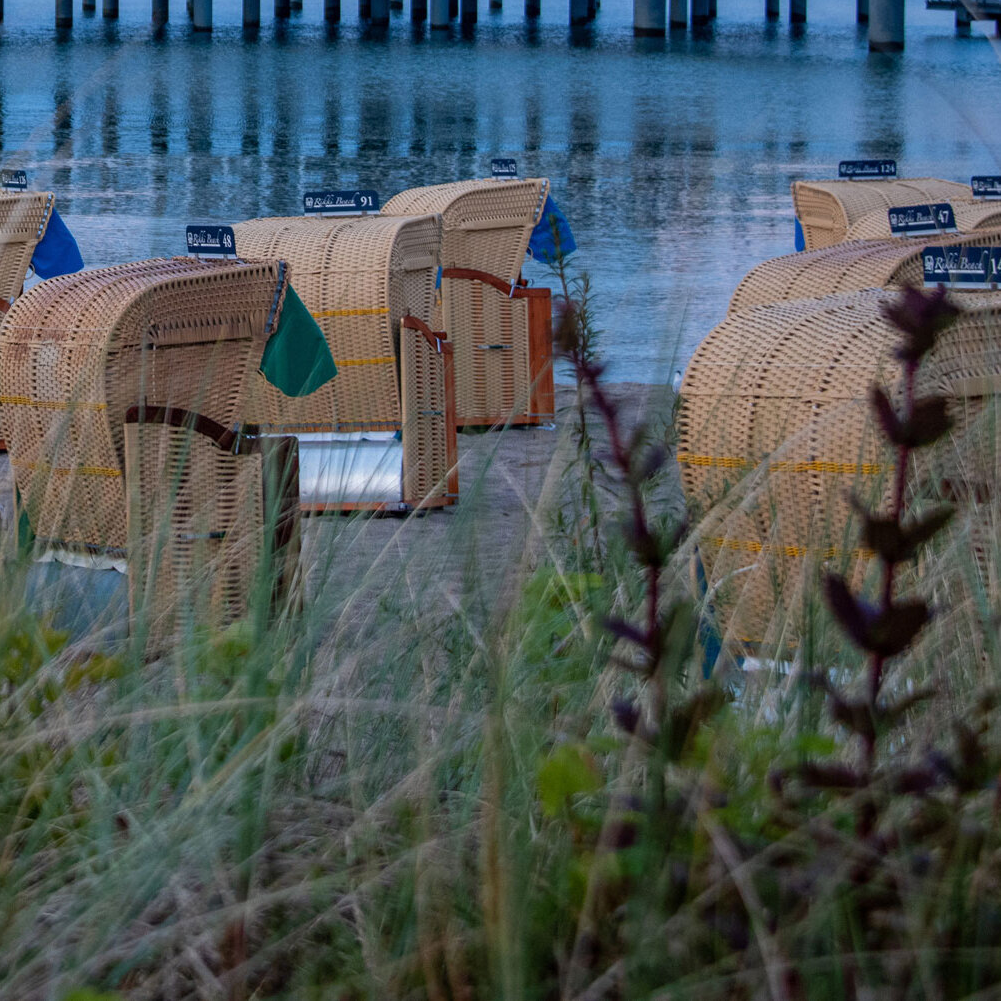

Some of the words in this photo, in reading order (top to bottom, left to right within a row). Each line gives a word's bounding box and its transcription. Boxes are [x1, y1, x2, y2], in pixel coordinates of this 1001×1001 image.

[360, 196, 373, 207] 91
[938, 210, 949, 224] 47
[222, 233, 232, 248] 48
[934, 252, 958, 272] Rikki
[960, 250, 989, 270] Beach
[990, 258, 1001, 275] 1
